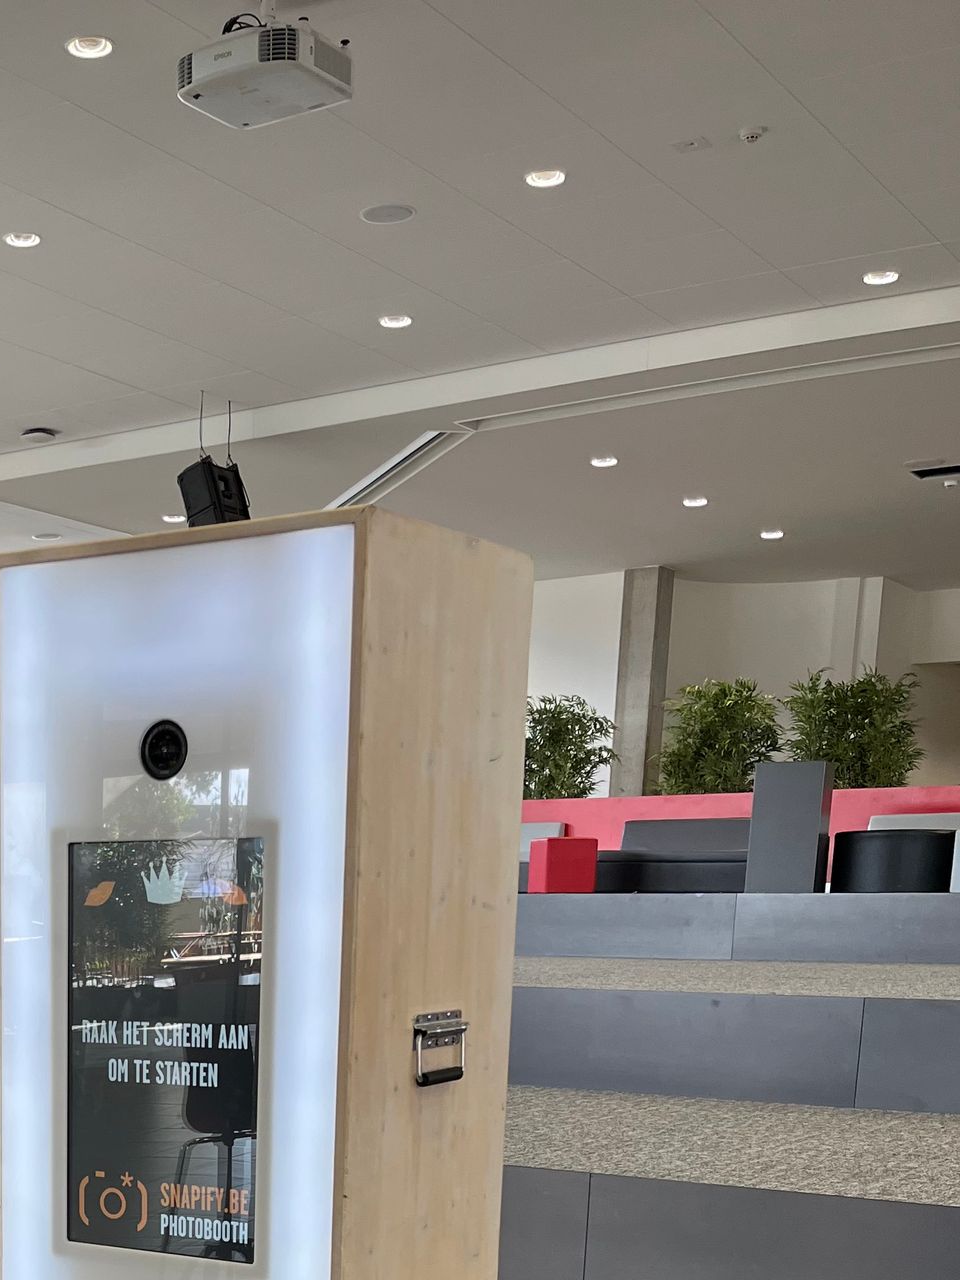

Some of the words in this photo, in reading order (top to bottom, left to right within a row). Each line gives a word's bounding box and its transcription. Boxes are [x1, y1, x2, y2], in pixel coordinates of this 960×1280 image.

[81, 1020, 117, 1045] RAAK
[123, 1021, 149, 1047] HET
[154, 1023, 212, 1049] SCHERM
[218, 1024, 248, 1050] AAN
[108, 1059, 129, 1083] OM
[133, 1060, 151, 1084] TE
[155, 1061, 218, 1088] STARTEN
[160, 1183, 249, 1216] SNAPIFY.BE
[160, 1214, 248, 1244] PHOTOBOOTH
